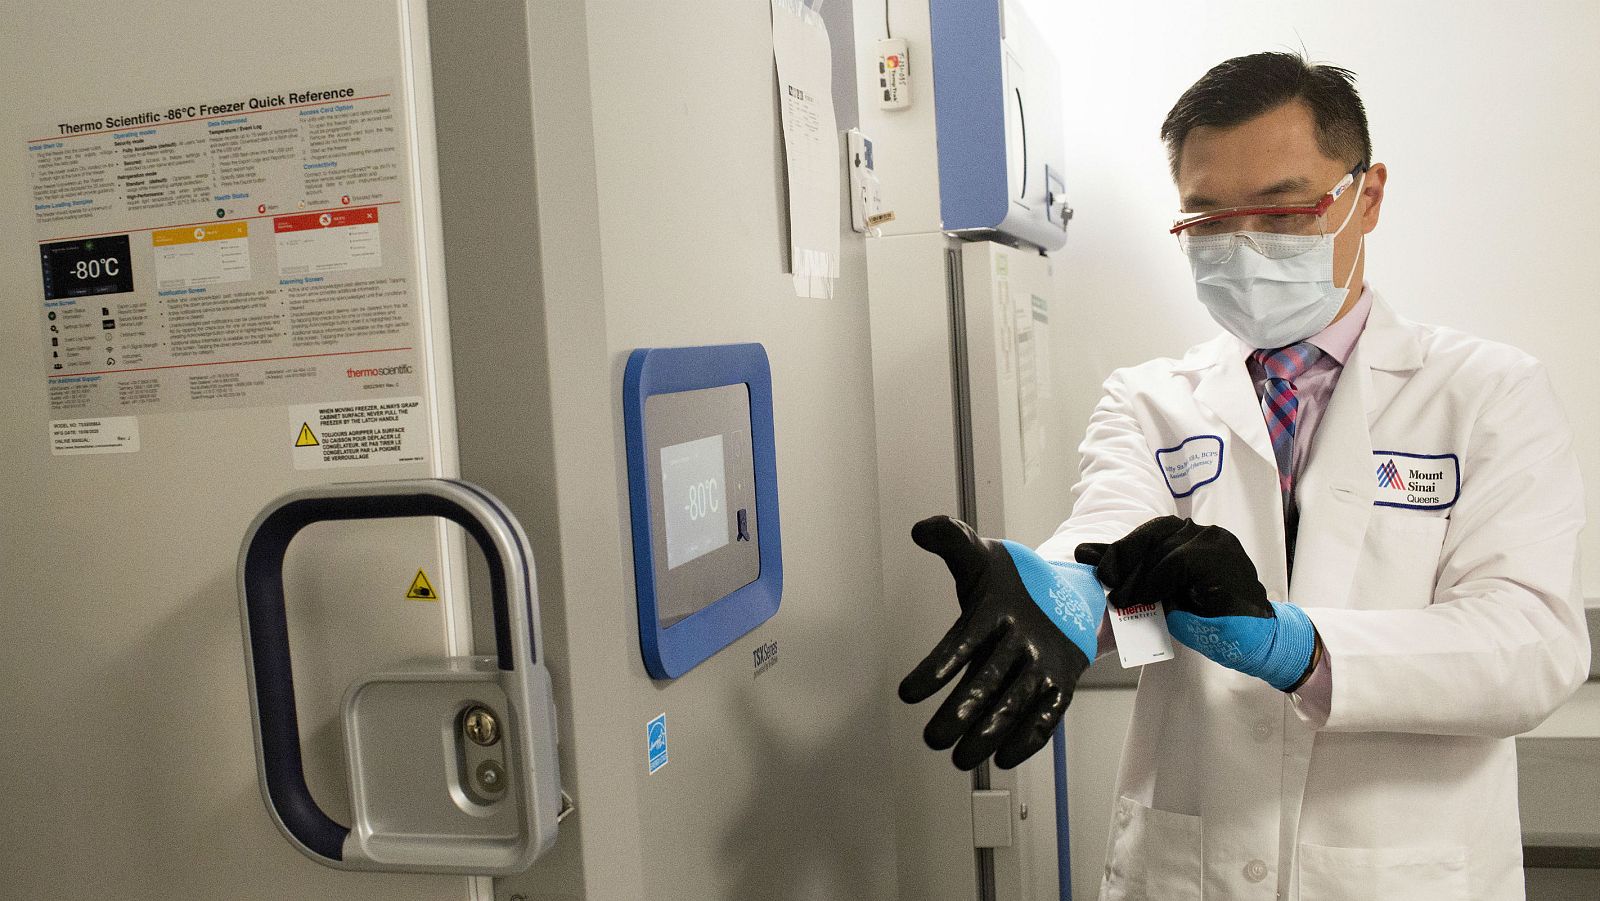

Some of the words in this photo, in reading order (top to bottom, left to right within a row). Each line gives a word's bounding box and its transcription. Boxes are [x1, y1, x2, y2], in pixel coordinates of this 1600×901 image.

[58, 122, 102, 135] Thermo
[106, 113, 160, 127] Scientific
[163, 106, 196, 120] -86°C
[201, 100, 245, 116] Freezer
[249, 95, 285, 109] Quick
[290, 87, 355, 104] Reference
[70, 257, 119, 280] -80°C
[346, 364, 412, 379] thermoscientific
[1409, 469, 1444, 481] Mount
[1408, 480, 1437, 493] Sinai
[685, 476, 719, 521] -80°C
[1407, 493, 1440, 505] Queens
[1119, 611, 1159, 623] SCIENTIFIC
